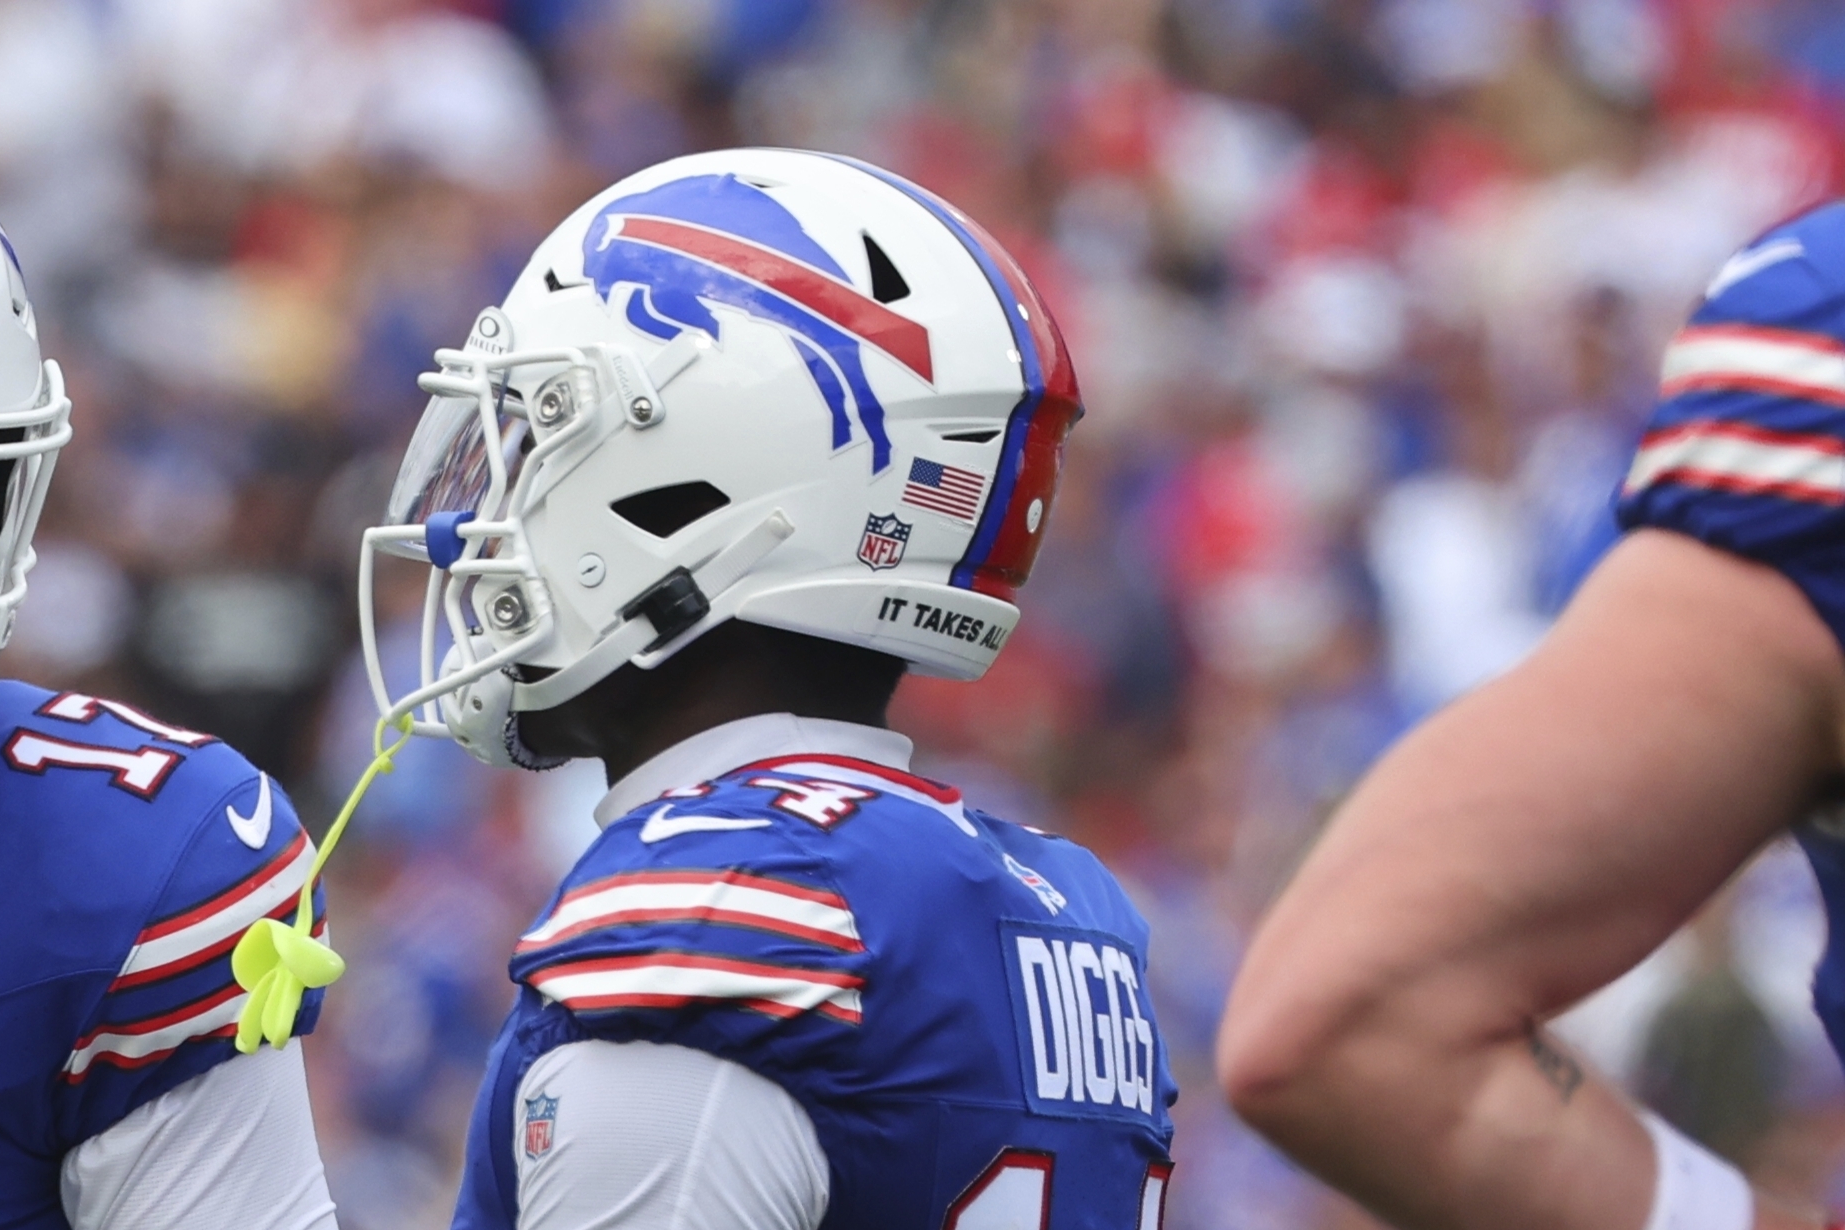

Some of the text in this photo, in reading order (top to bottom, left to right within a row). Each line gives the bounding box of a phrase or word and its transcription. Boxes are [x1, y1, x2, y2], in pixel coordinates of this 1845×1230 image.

[861, 534, 899, 566] NFL
[878, 597, 908, 622] IT
[913, 603, 984, 643] TAKES
[0, 691, 222, 802] 17
[1016, 936, 1153, 1116] DIGGS
[528, 1121, 551, 1155] NFL
